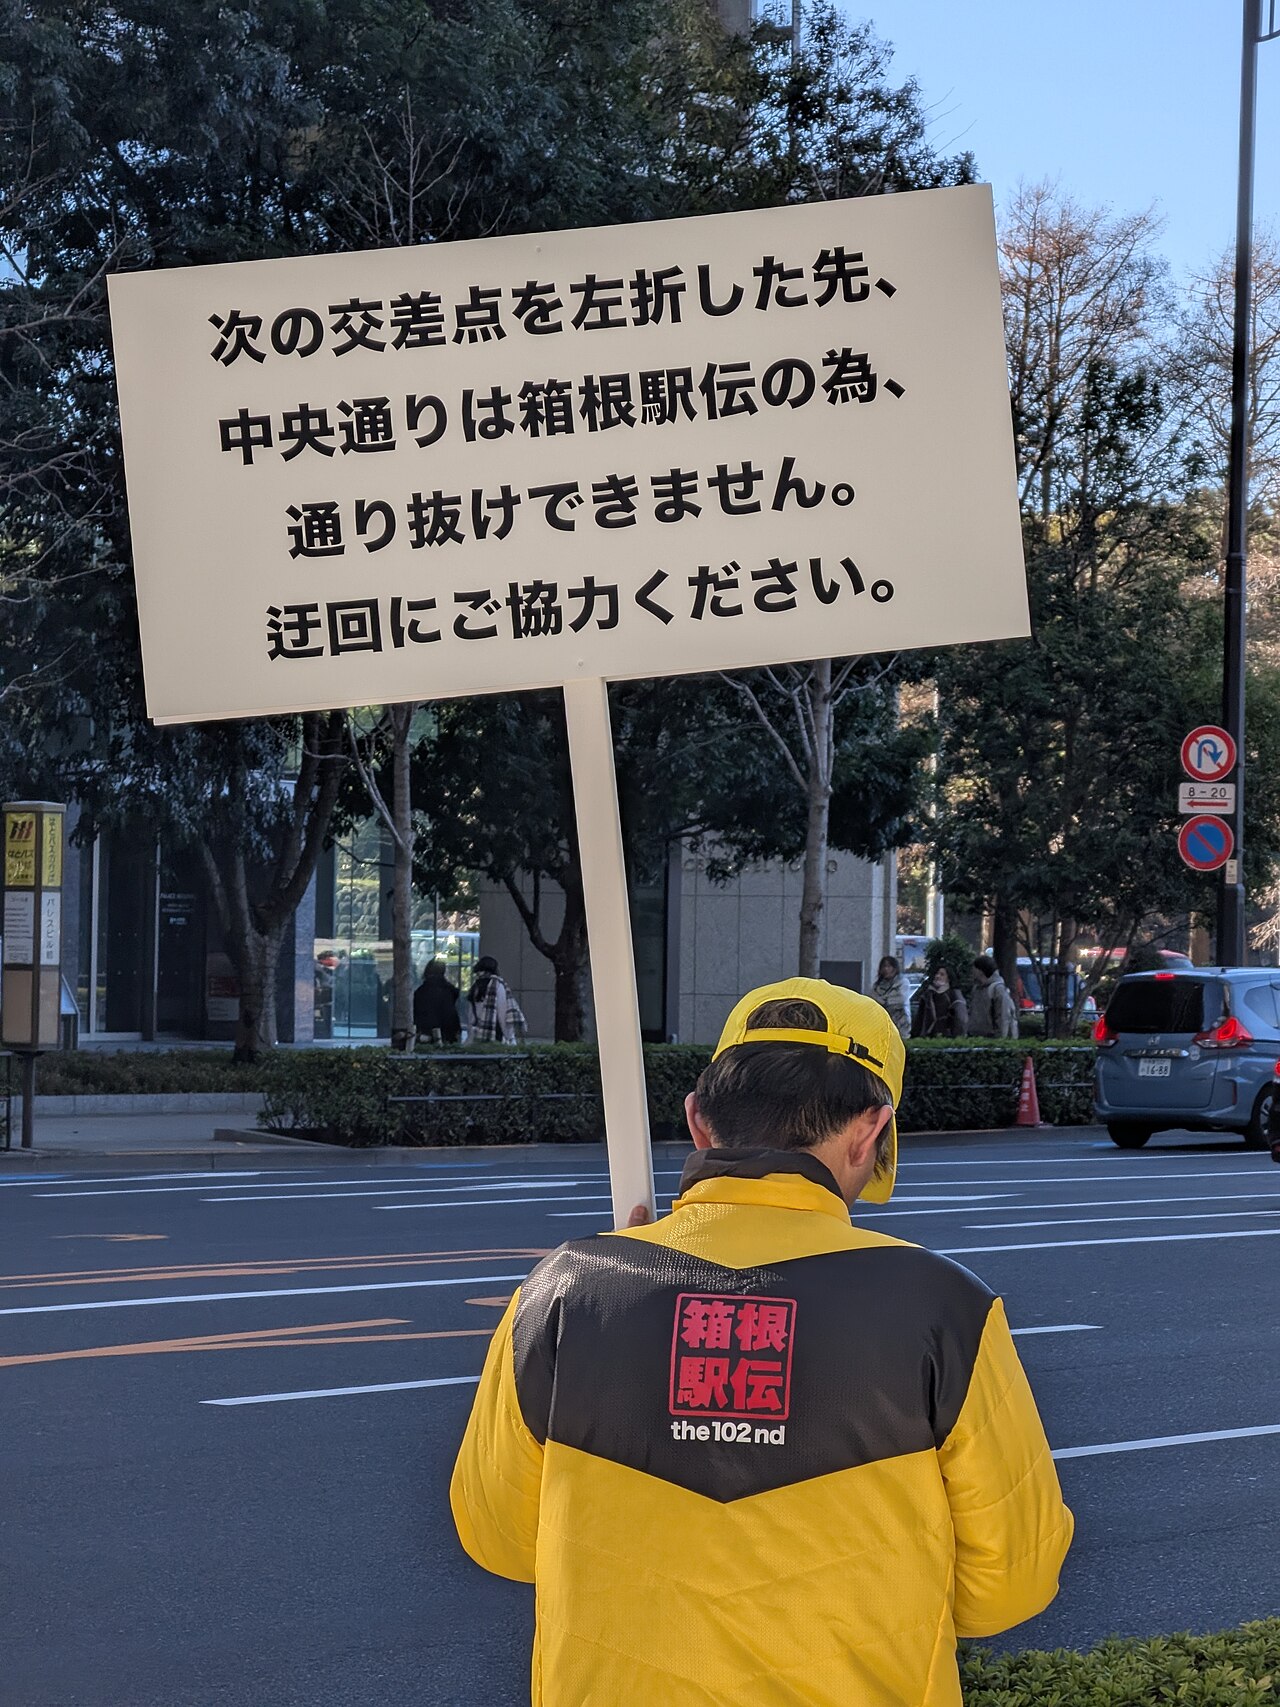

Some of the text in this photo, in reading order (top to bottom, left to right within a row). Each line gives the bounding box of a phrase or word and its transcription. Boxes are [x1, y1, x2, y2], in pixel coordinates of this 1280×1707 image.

[207, 246, 897, 368] 次の交差点を左折した先、
[218, 347, 906, 466] 中央通りは箱根駅伝の為、
[285, 456, 855, 560] 通り抜けできません。
[265, 557, 894, 661] 迂回にご協力ください。
[681, 1300, 788, 1352] 箱根
[677, 1356, 784, 1411] 駅伝
